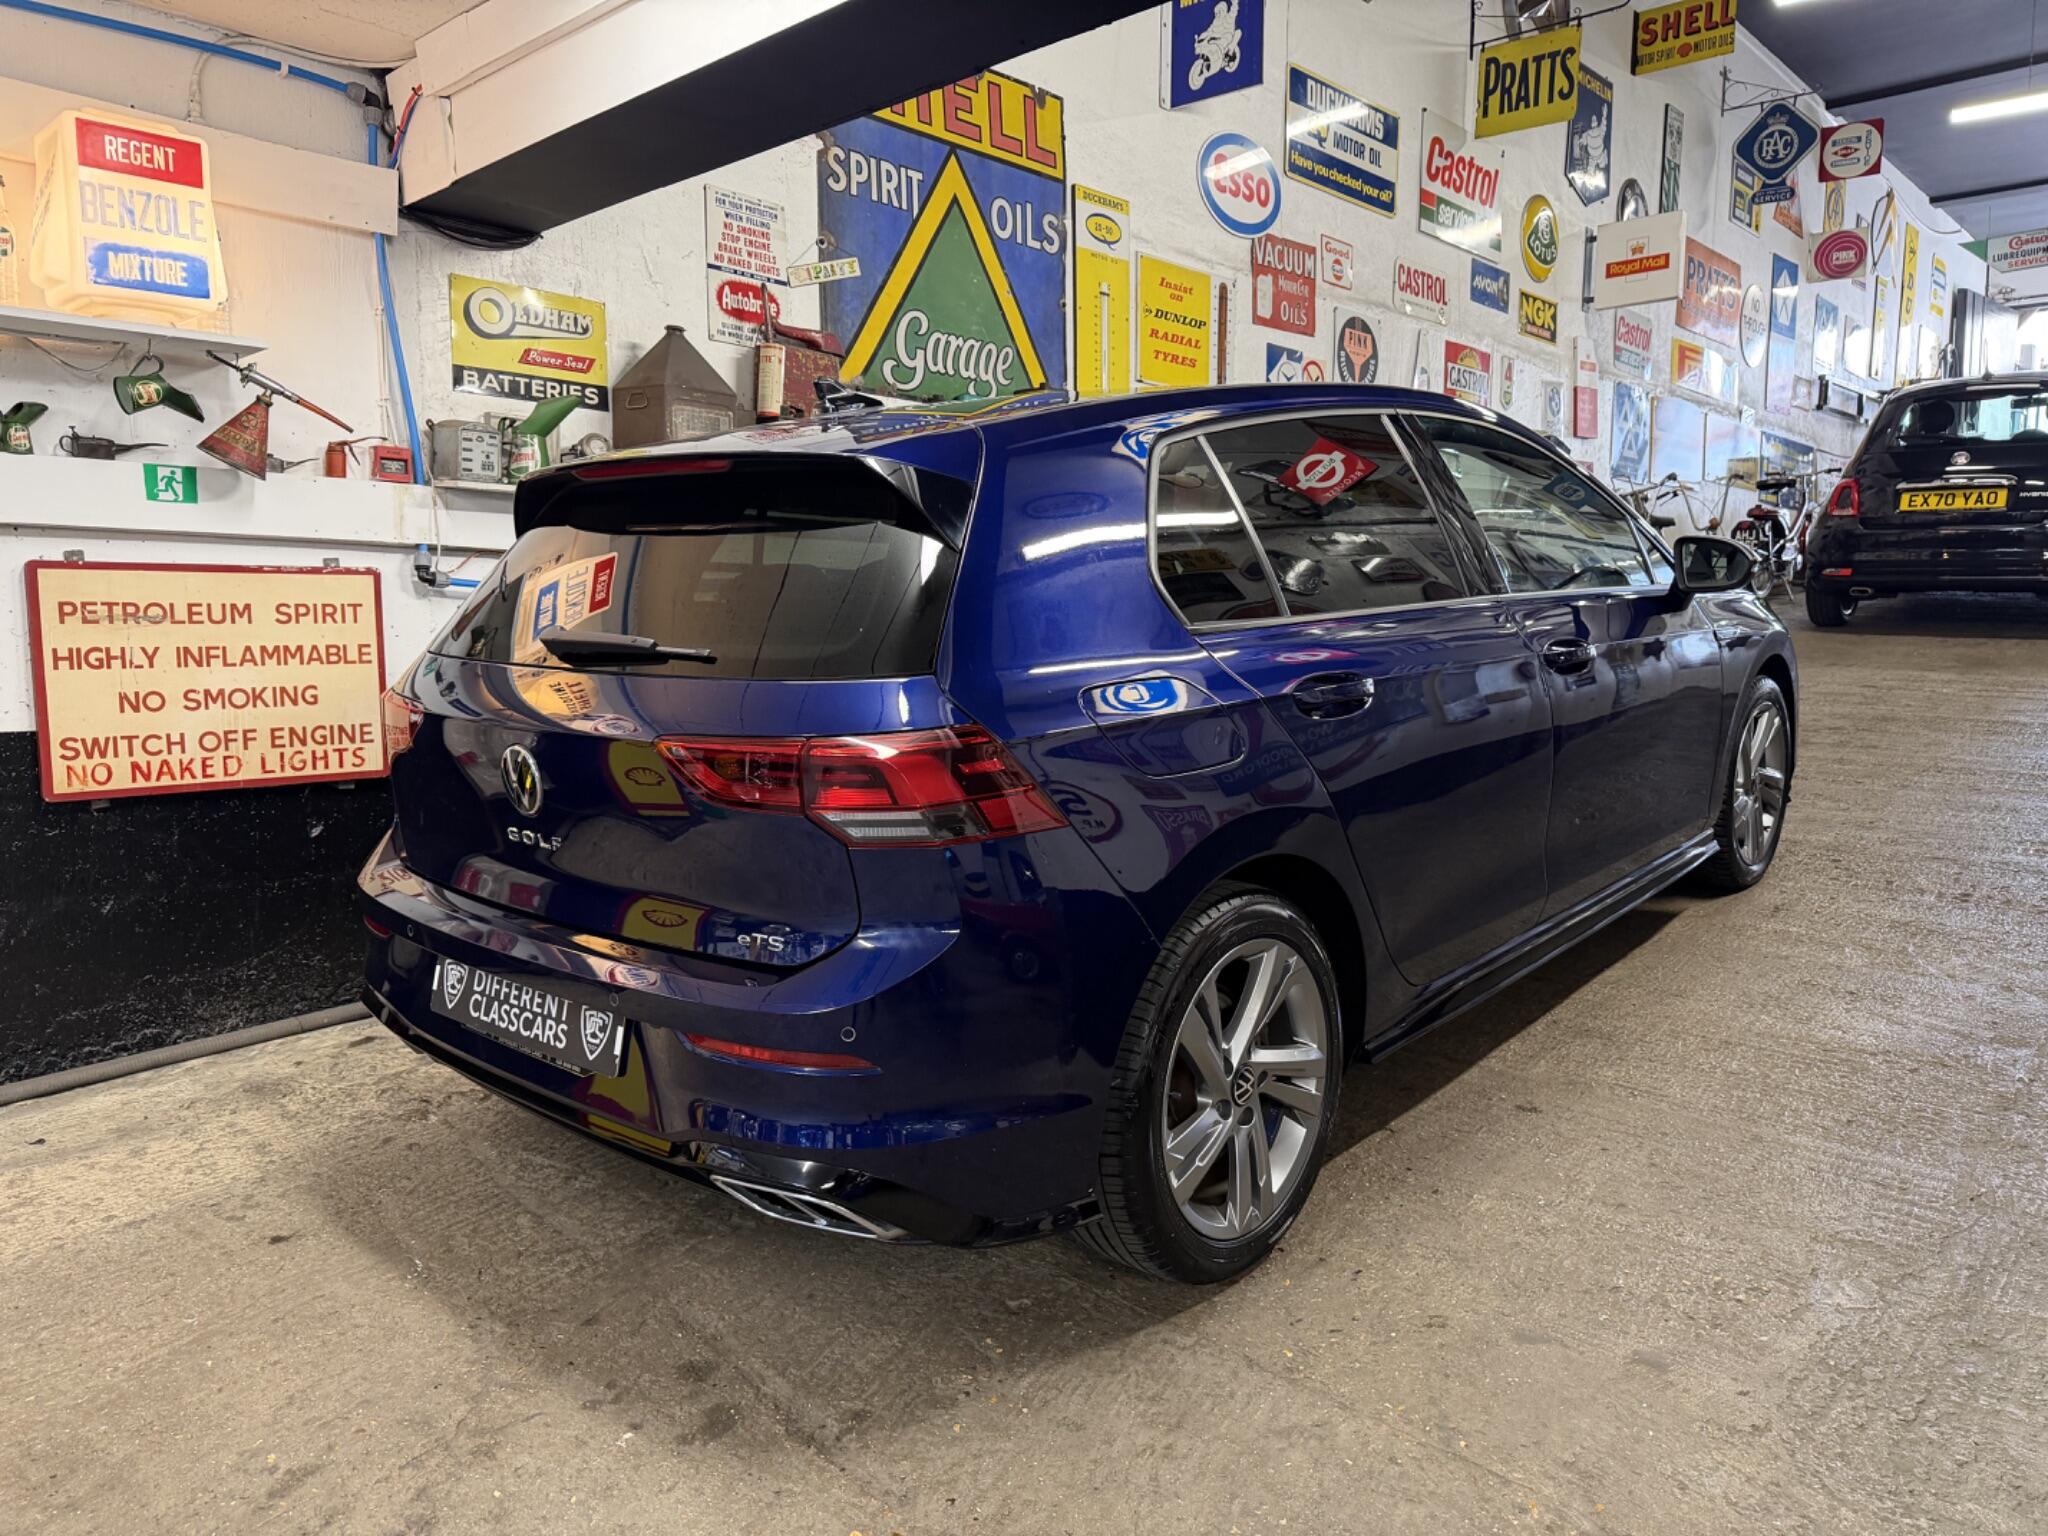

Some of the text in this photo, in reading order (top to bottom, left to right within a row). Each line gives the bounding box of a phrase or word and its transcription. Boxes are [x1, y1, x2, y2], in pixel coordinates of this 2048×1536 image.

[1640, 0, 1735, 47] SHELL
[1638, 52, 1655, 66] OTOR
[1693, 38, 1717, 53] MOTOR
[1482, 47, 1577, 118] PRATTS
[890, 75, 1057, 169] ELL
[104, 135, 176, 172] REGENT
[1333, 131, 1381, 168] MOTOR OIL
[1762, 131, 1791, 160] RAC
[826, 145, 923, 220] SPIRIT
[1213, 153, 1270, 208] Esso
[1291, 150, 1392, 203] Have you checked your oil?
[1426, 136, 1500, 208] Castrol
[79, 180, 208, 243] BENZOLE
[715, 196, 726, 206] FOR
[728, 200, 743, 210] YOUR
[745, 205, 778, 220] PROTECTION
[724, 211, 771, 230] WHEN FILLING
[723, 221, 771, 241] NO SMOKING
[990, 197, 1060, 254] OILS
[718, 242, 776, 265] BRAKE WHEELS
[721, 232, 771, 252] STOP ENGINE
[1325, 241, 1350, 260] Good
[1529, 234, 1557, 261] LOTUS
[1833, 251, 1856, 262] PINK
[108, 251, 188, 287] MIXTURE
[714, 253, 725, 263] NO
[727, 256, 752, 270] NAKED
[755, 262, 781, 277] LIGHTS
[1253, 236, 1315, 279] VACUUM
[1610, 254, 1665, 275] Royal Mail
[1159, 277, 1193, 295] Insist
[1398, 264, 1447, 306] CASTROL
[1473, 275, 1498, 297] AVON
[1687, 255, 1736, 309] PRATTS
[722, 285, 777, 317] Autobrte
[1170, 293, 1183, 303] on
[464, 287, 592, 339] OLDHAM
[1154, 308, 1206, 329] DUNLOP
[1281, 301, 1307, 325] OILS
[1522, 295, 1555, 331] NGK
[717, 328, 726, 336] FOR
[728, 331, 744, 341] WHOLE
[1149, 328, 1201, 349] RADIAL
[1618, 316, 1652, 352] Castrol
[528, 350, 589, 370] Power Seal
[882, 310, 1013, 398] Garage
[1153, 350, 1197, 368] TYRES
[462, 370, 599, 405] BATTERIES
[1449, 365, 1488, 395] CASTROL
[1908, 491, 1998, 508] EX70 YAO
[58, 601, 363, 625] PETROLEUM SPIRIT
[52, 644, 372, 671] HIGHLY INFLAMMABLE
[118, 685, 319, 714] NO SMOKING
[59, 731, 186, 761] SWITCH
[199, 728, 257, 752] OFF
[270, 723, 374, 747] ENGINE
[66, 746, 365, 787] NO NAKED LIGHTS
[507, 826, 561, 851] GOLF
[473, 970, 573, 1021] DIFFERENT
[469, 994, 568, 1049] CLASSCARS
